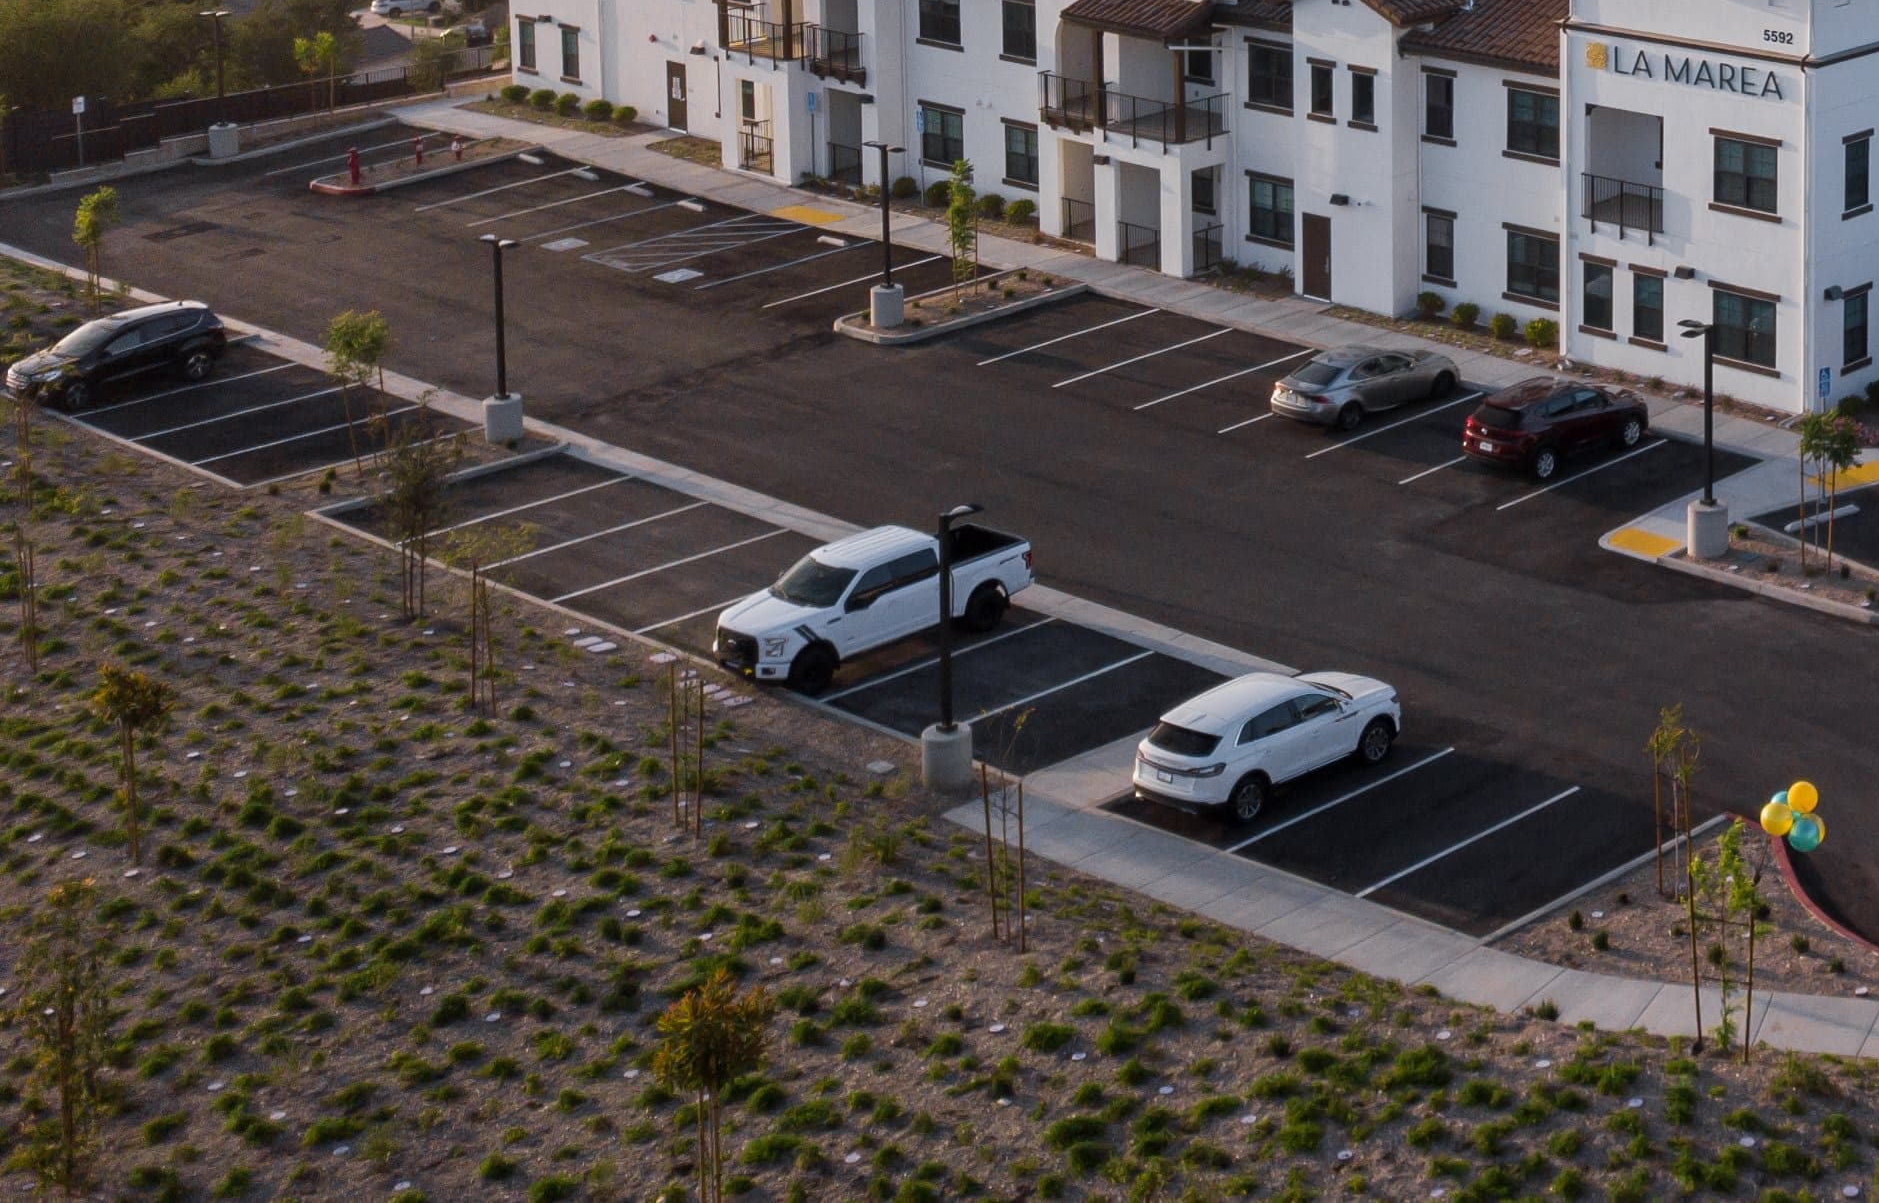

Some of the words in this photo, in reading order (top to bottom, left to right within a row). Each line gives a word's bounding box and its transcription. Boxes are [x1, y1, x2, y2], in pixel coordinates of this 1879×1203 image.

[1764, 30, 1793, 44] 5592
[1614, 46, 1652, 78] LA
[1665, 54, 1783, 100] MAREA
